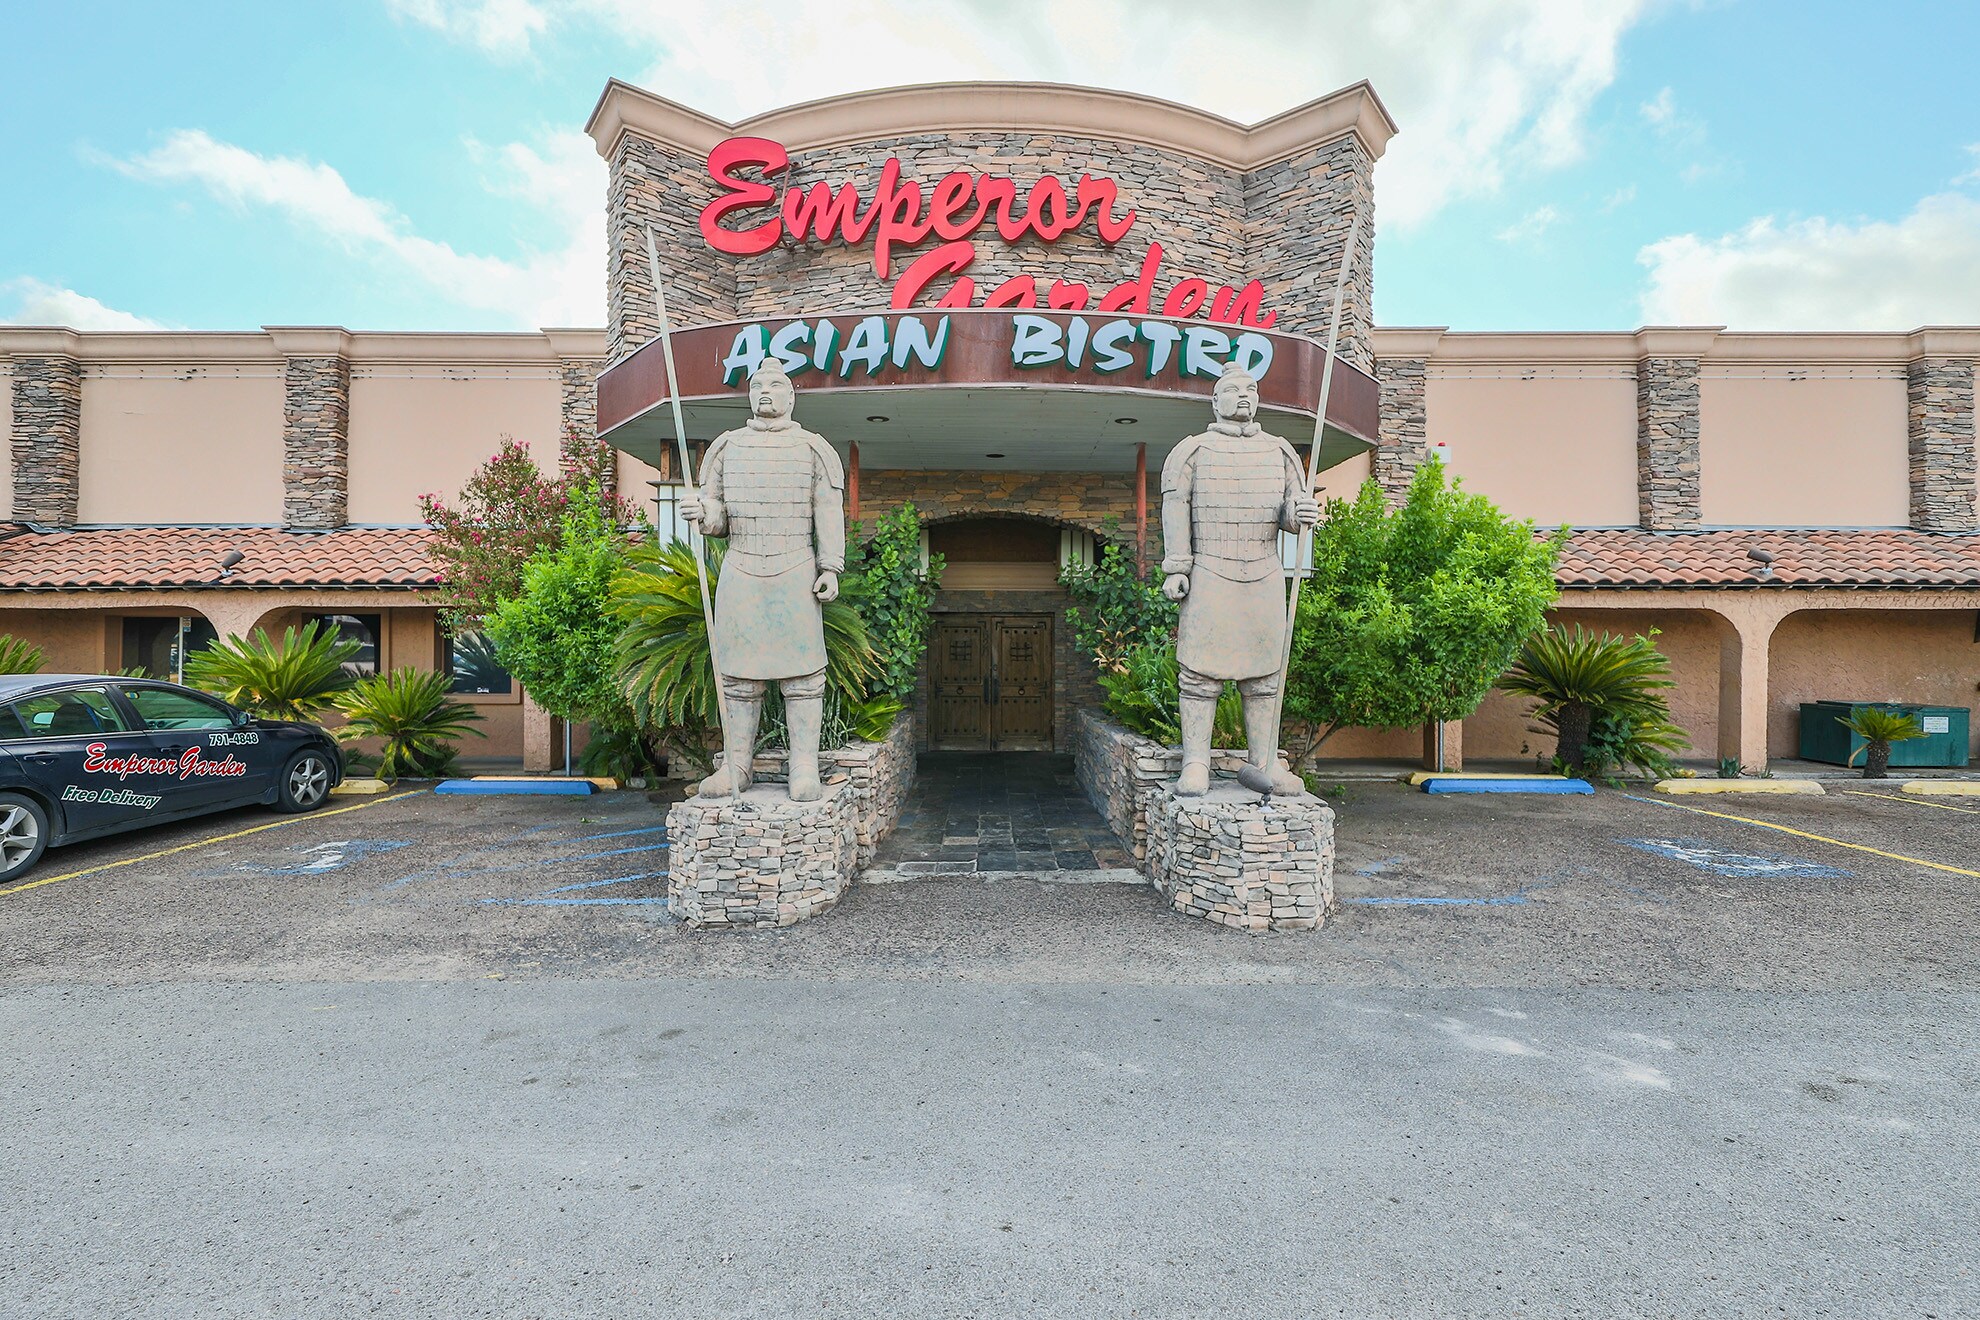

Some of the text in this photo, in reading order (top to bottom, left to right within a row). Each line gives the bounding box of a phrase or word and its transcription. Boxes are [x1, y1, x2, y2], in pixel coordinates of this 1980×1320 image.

[698, 137, 1137, 281] Emperor
[722, 314, 1275, 389] ASIAN BISTRO
[208, 732, 259, 746] 791-4848
[84, 742, 246, 781] Emperor Garden
[61, 785, 162, 810] Free Delivery
